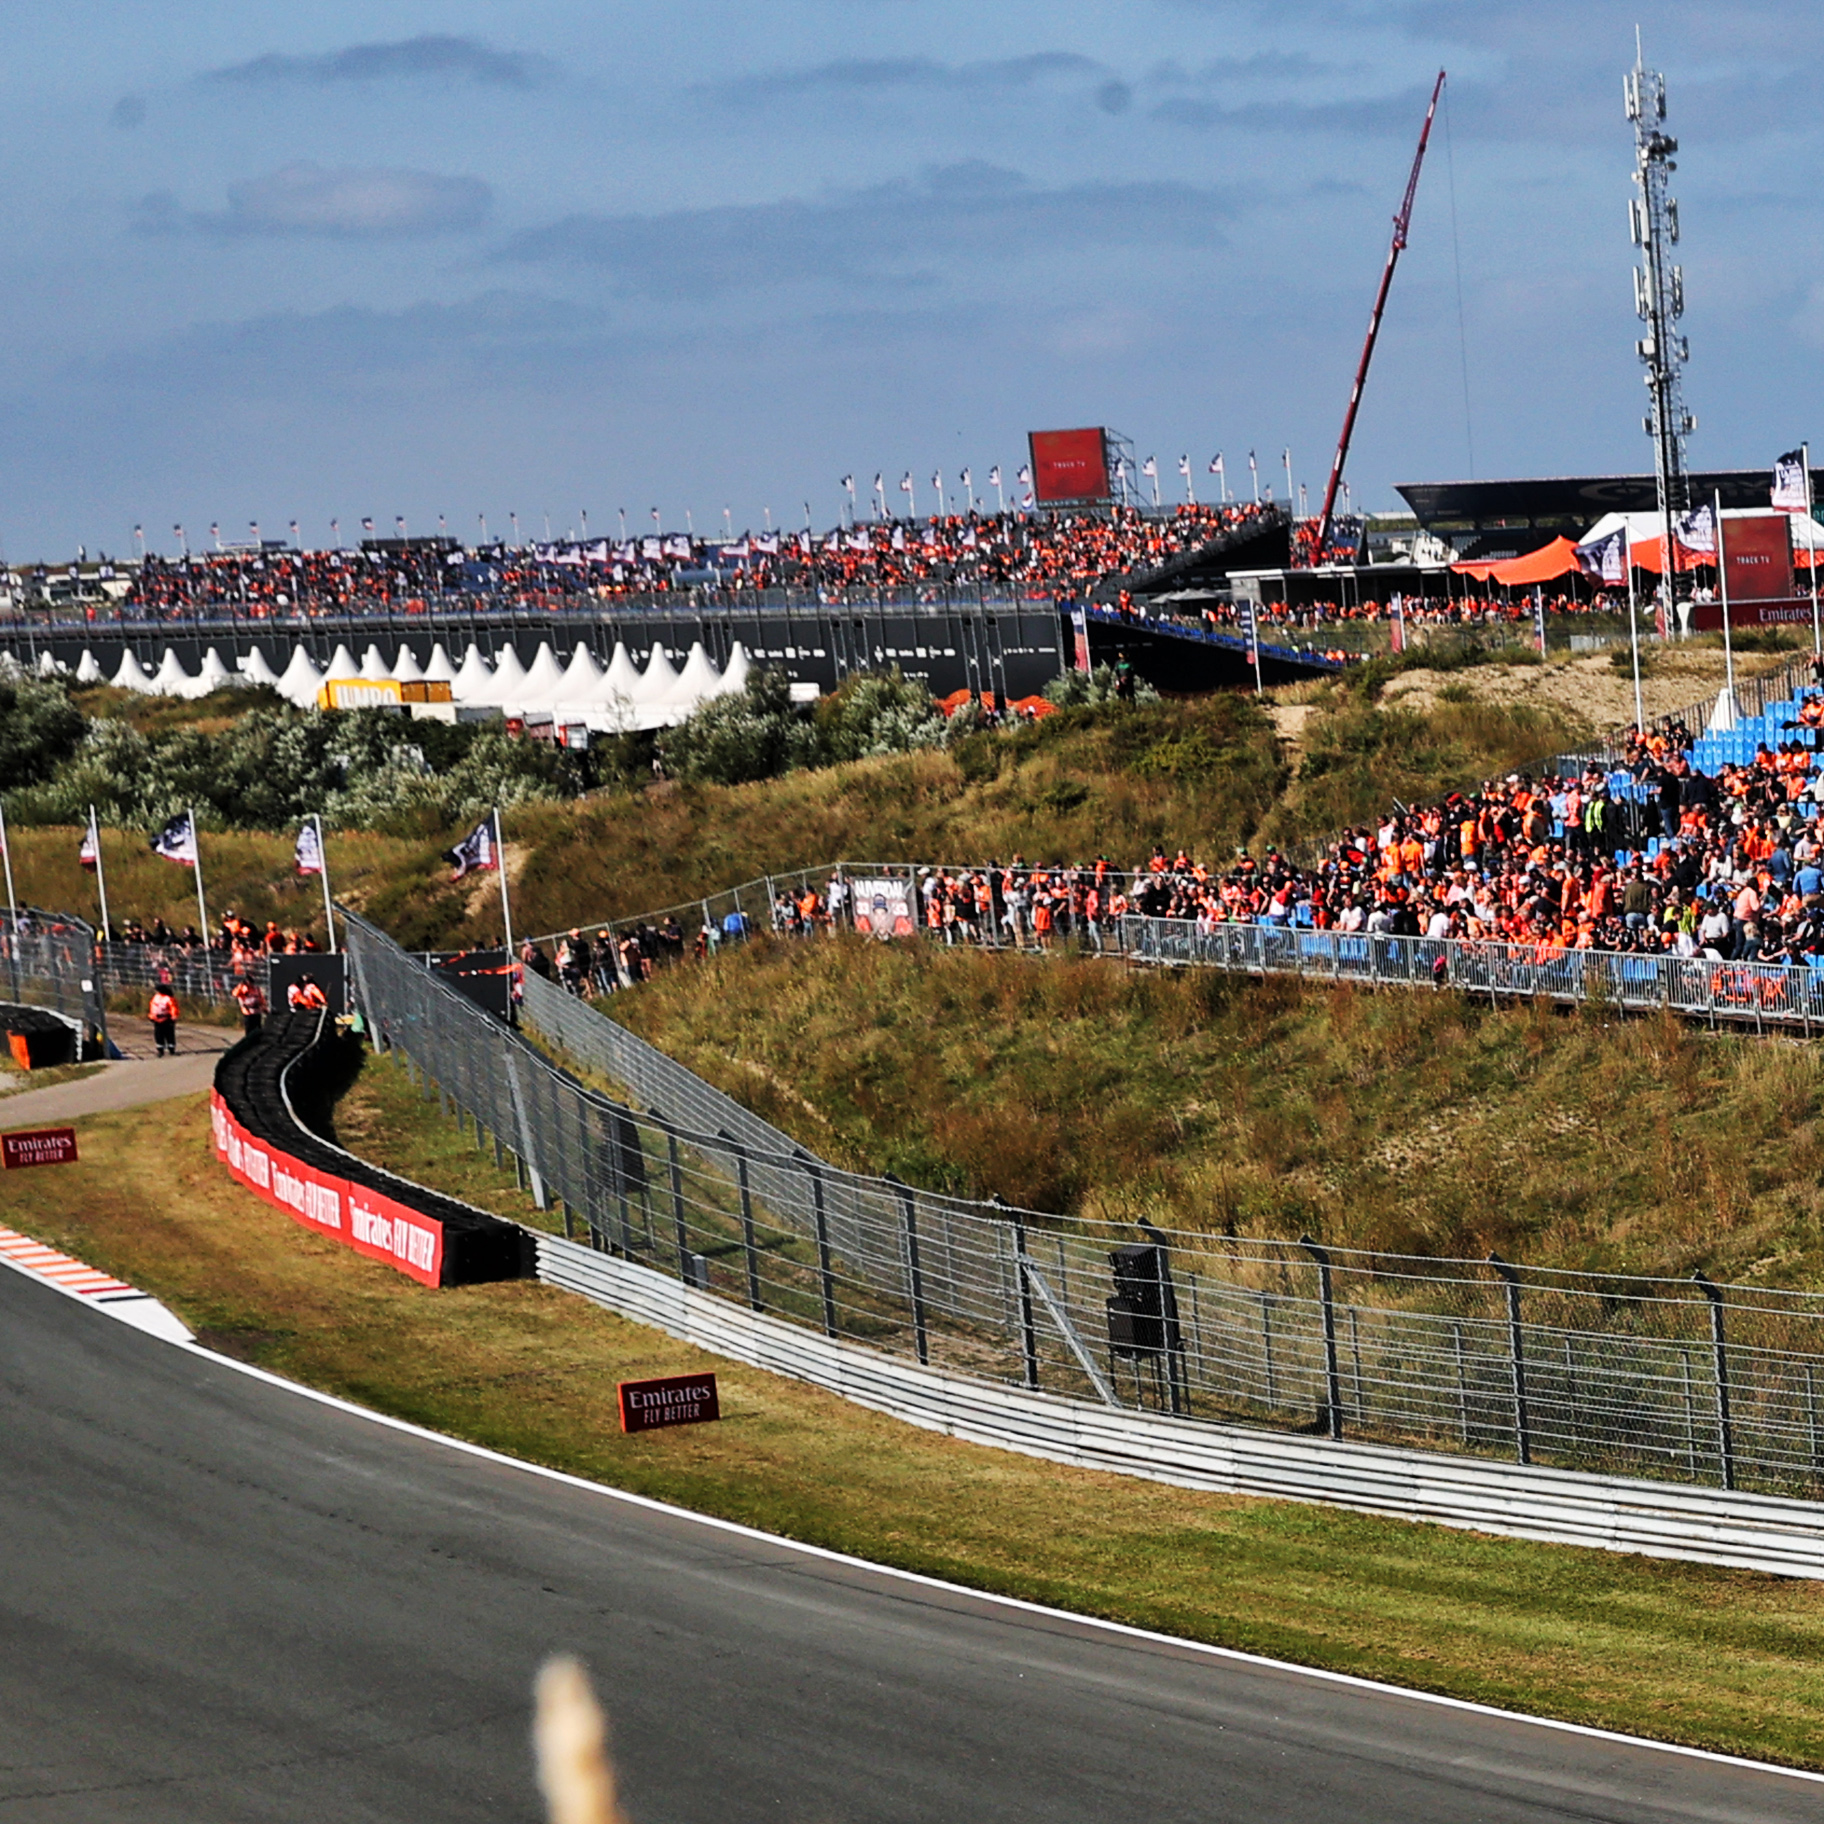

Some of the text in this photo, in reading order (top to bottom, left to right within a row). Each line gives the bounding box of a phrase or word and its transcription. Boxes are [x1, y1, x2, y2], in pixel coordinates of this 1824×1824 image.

[1759, 605, 1812, 622] Emirates
[8, 1136, 72, 1153] Emirates
[629, 1385, 711, 1409] Emirates
[643, 1403, 701, 1424] FLY BETTER
